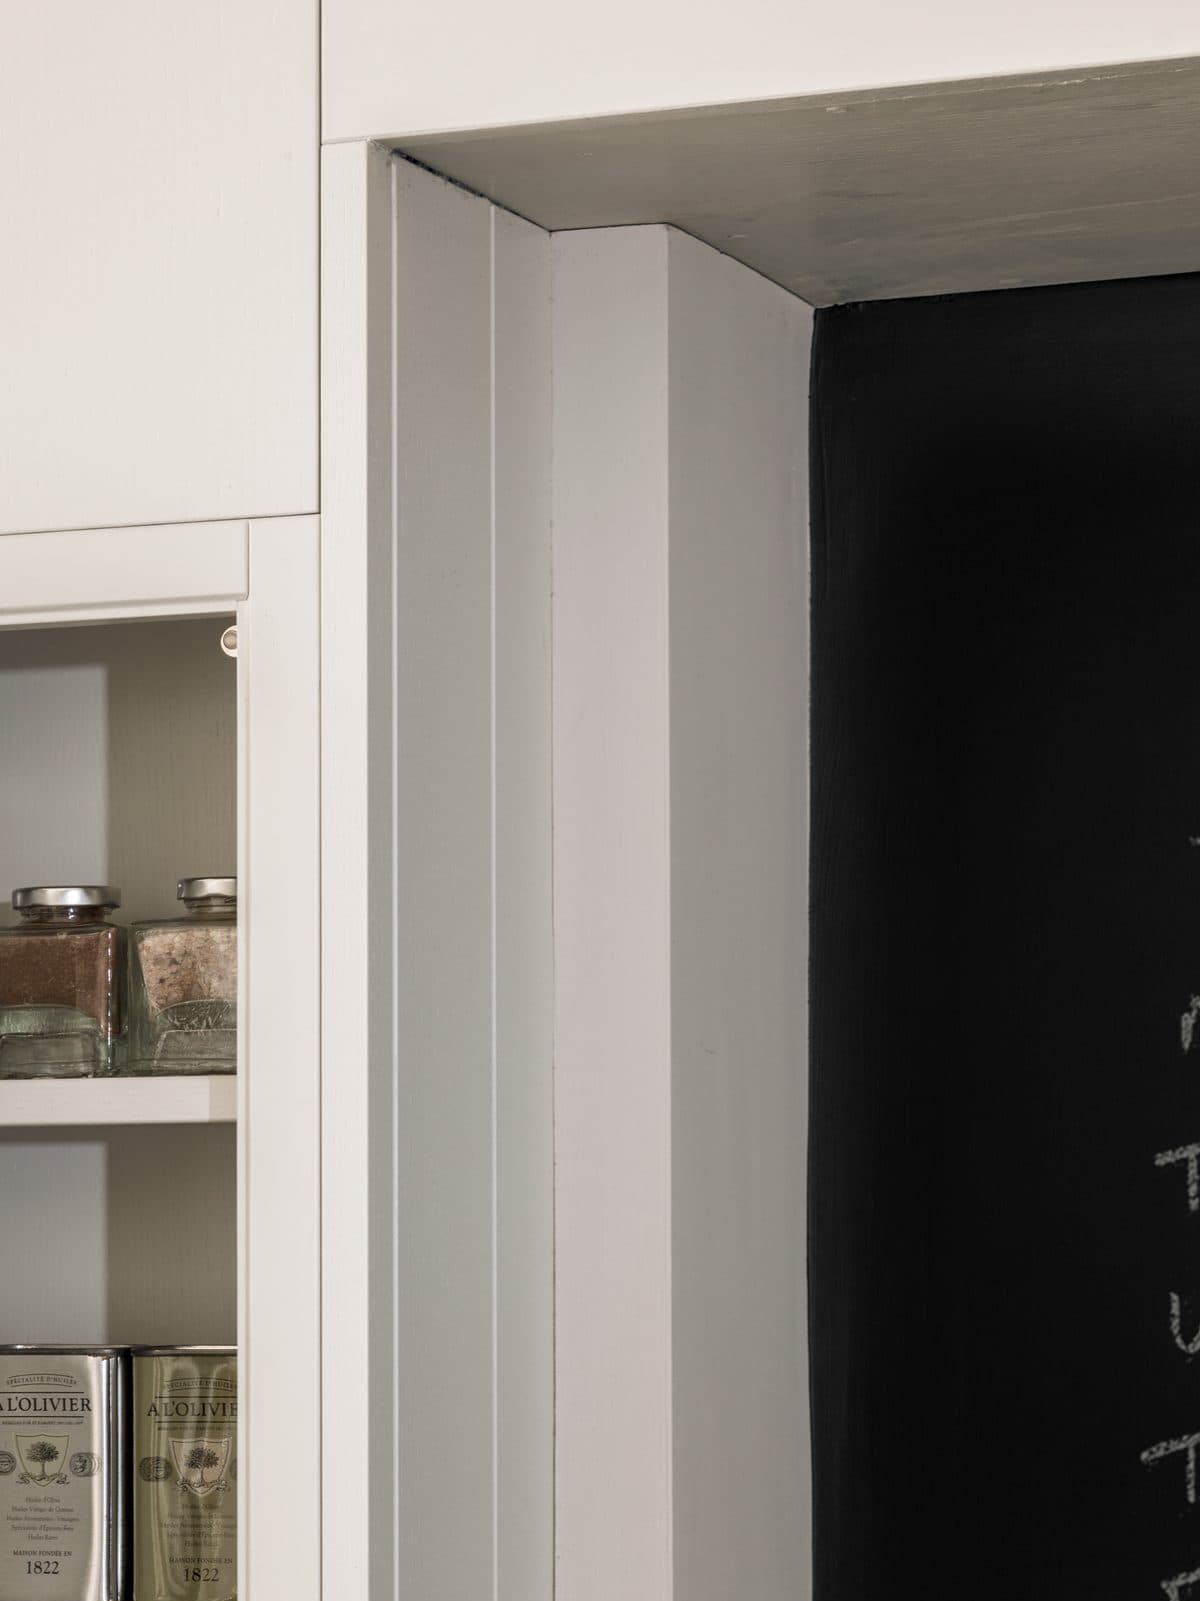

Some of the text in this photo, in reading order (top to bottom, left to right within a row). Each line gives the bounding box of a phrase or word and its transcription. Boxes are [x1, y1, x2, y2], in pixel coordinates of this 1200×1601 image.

[7, 1396, 93, 1412] L'OLIVIER
[162, 1400, 238, 1417] L'OLIVIE
[26, 1560, 60, 1575] 1822
[183, 1567, 220, 1583] 1822
